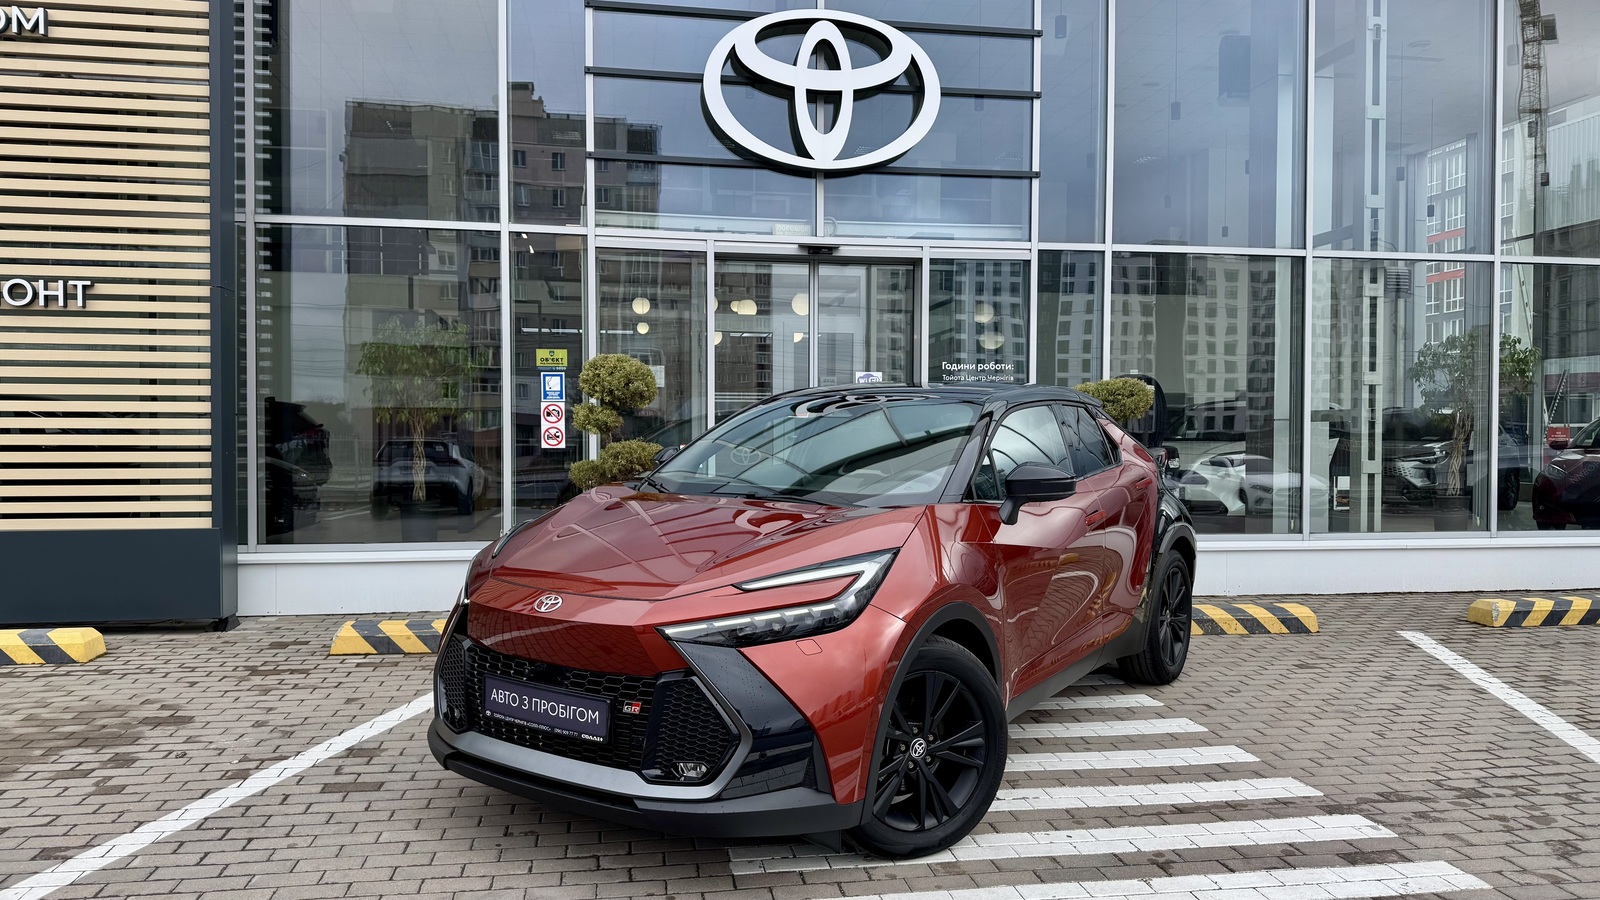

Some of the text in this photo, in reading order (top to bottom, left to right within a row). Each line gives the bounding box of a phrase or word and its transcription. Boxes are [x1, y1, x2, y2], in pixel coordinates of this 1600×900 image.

[0, 5, 45, 35] М
[942, 361, 1014, 372] Години роботи:
[966, 374, 986, 382] Центр
[491, 688, 519, 707] АВТО
[532, 698, 599, 725] ПРОБІГОМ
